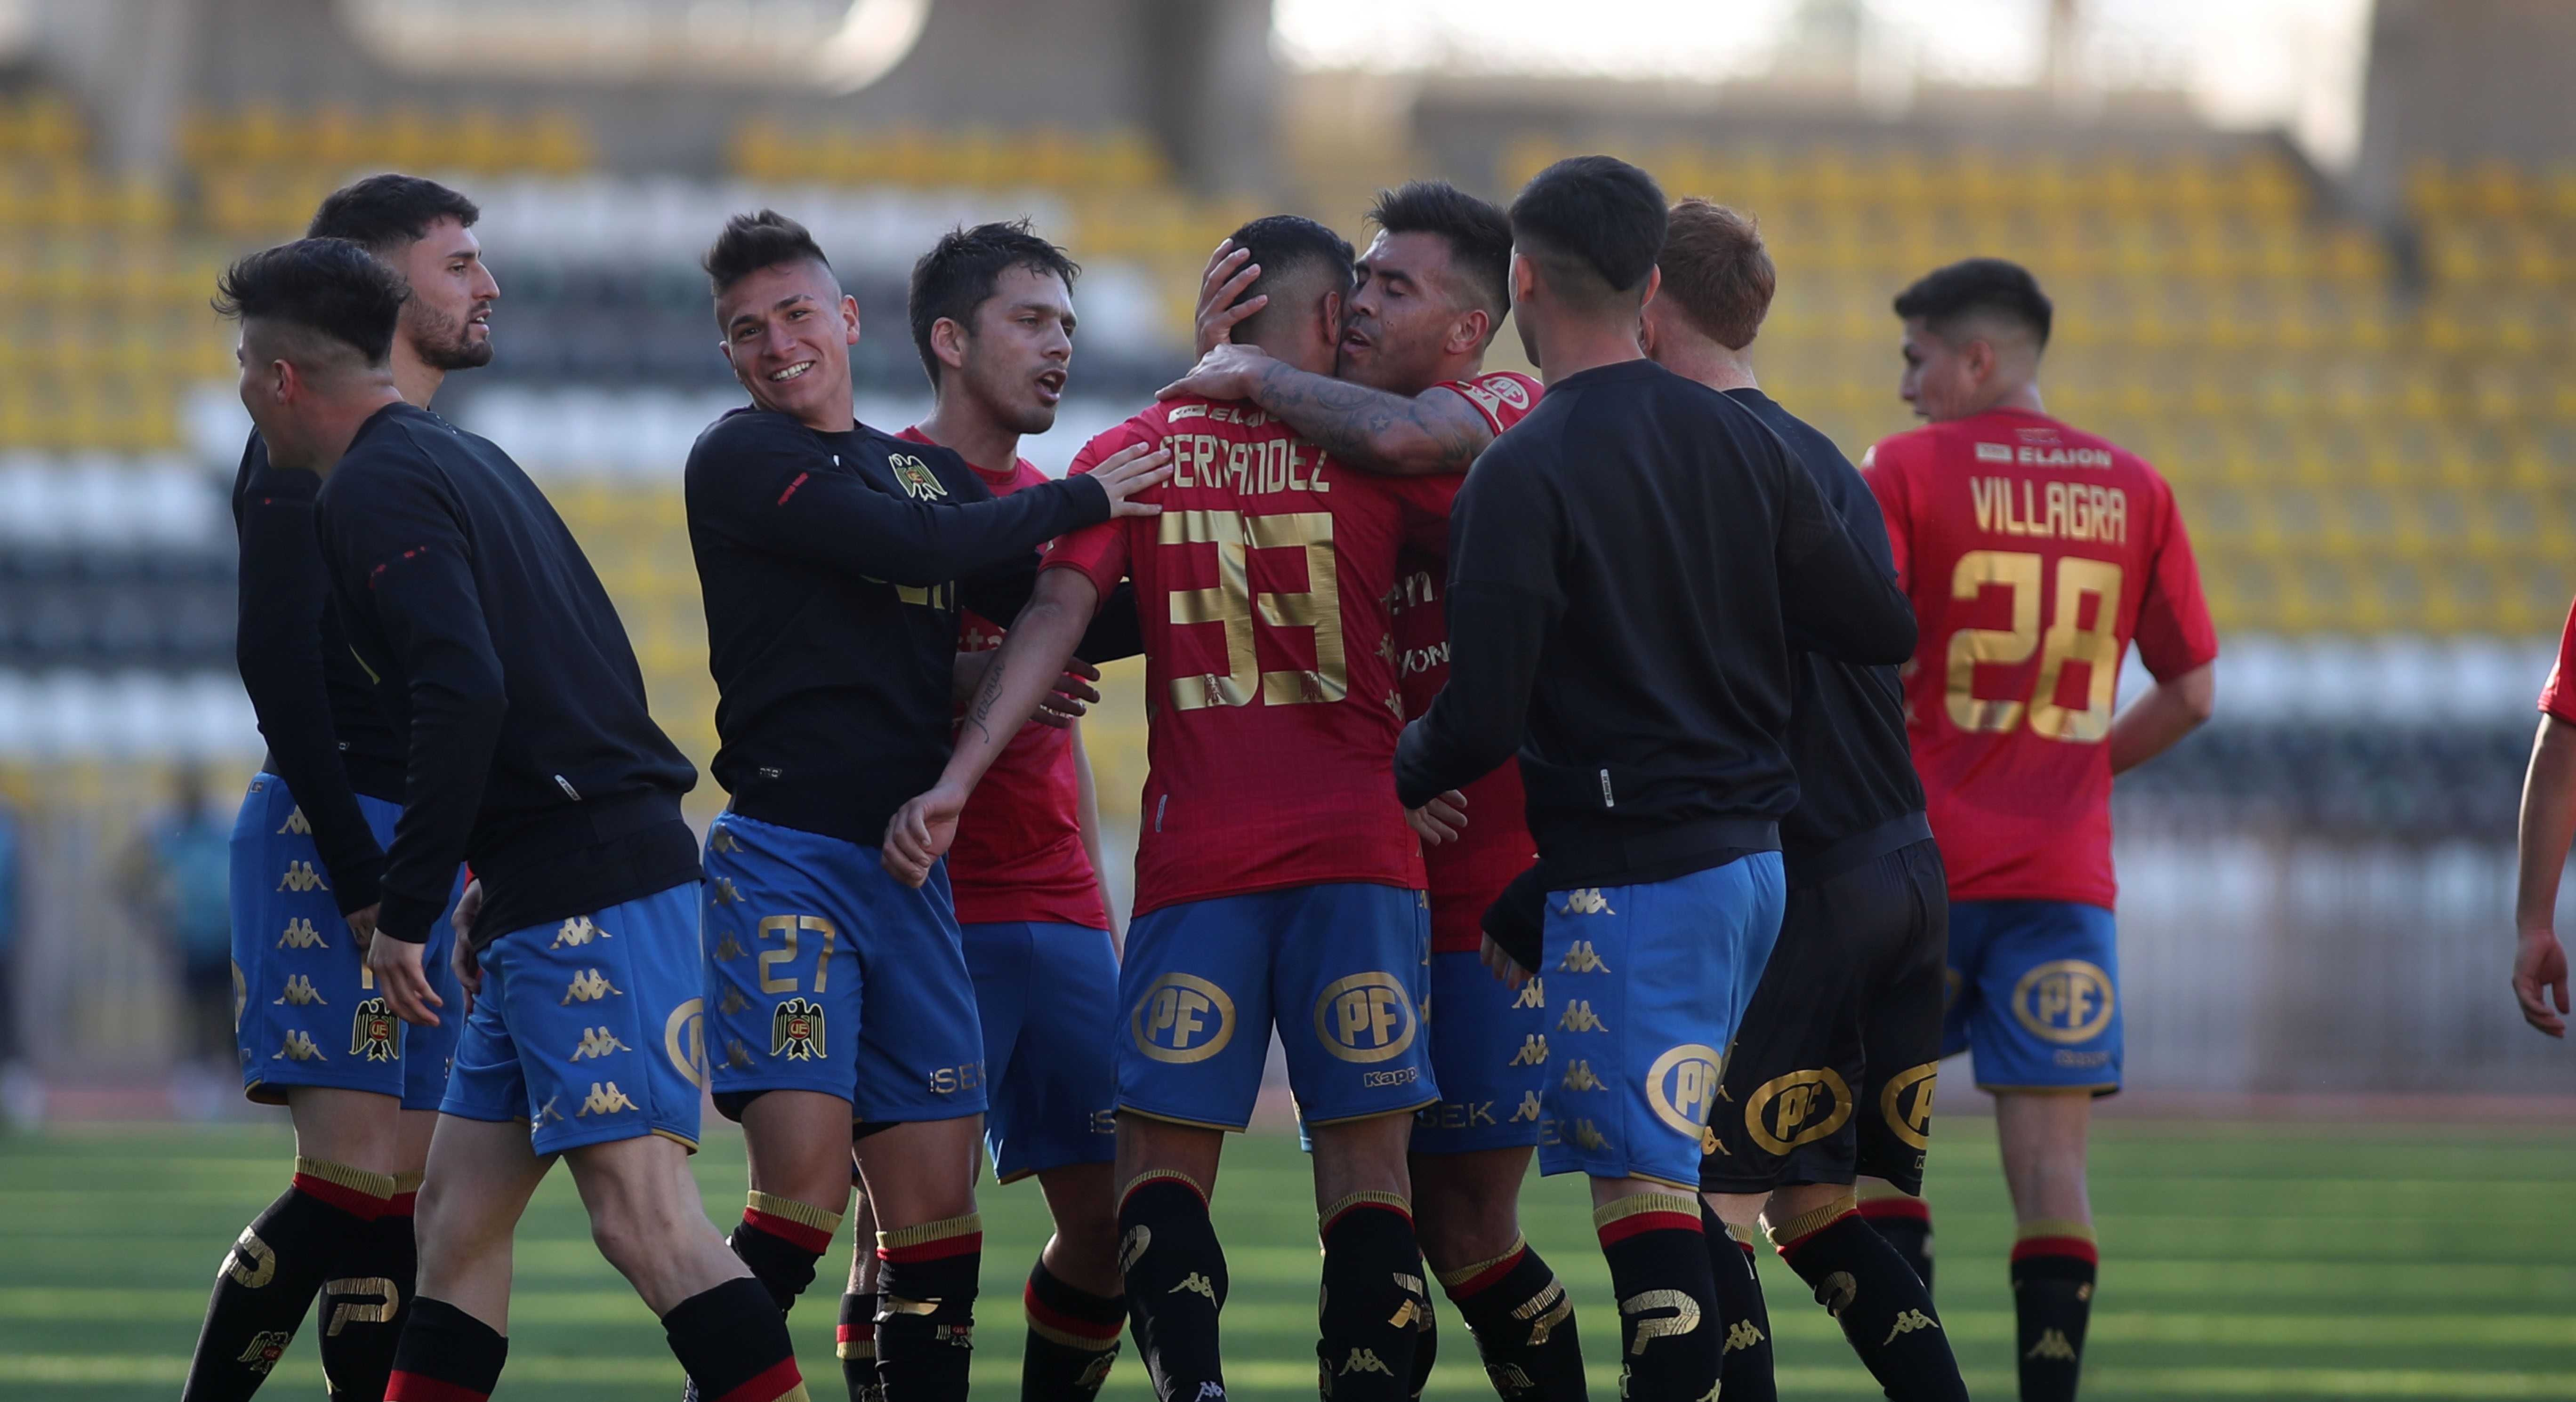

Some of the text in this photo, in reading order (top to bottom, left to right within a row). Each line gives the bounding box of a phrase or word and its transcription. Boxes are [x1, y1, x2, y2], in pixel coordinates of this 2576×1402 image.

[2018, 445, 2112, 468] ELAION
[1970, 476, 2126, 545] VILLAGRA
[1158, 510, 1347, 711] 33
[1945, 549, 2123, 745] 28
[758, 914, 836, 994] 27
[790, 1023, 807, 1035] UE
[1146, 988, 1209, 1048] PF
[1336, 988, 1396, 1046] PF
[2038, 971, 2096, 1027] PF
